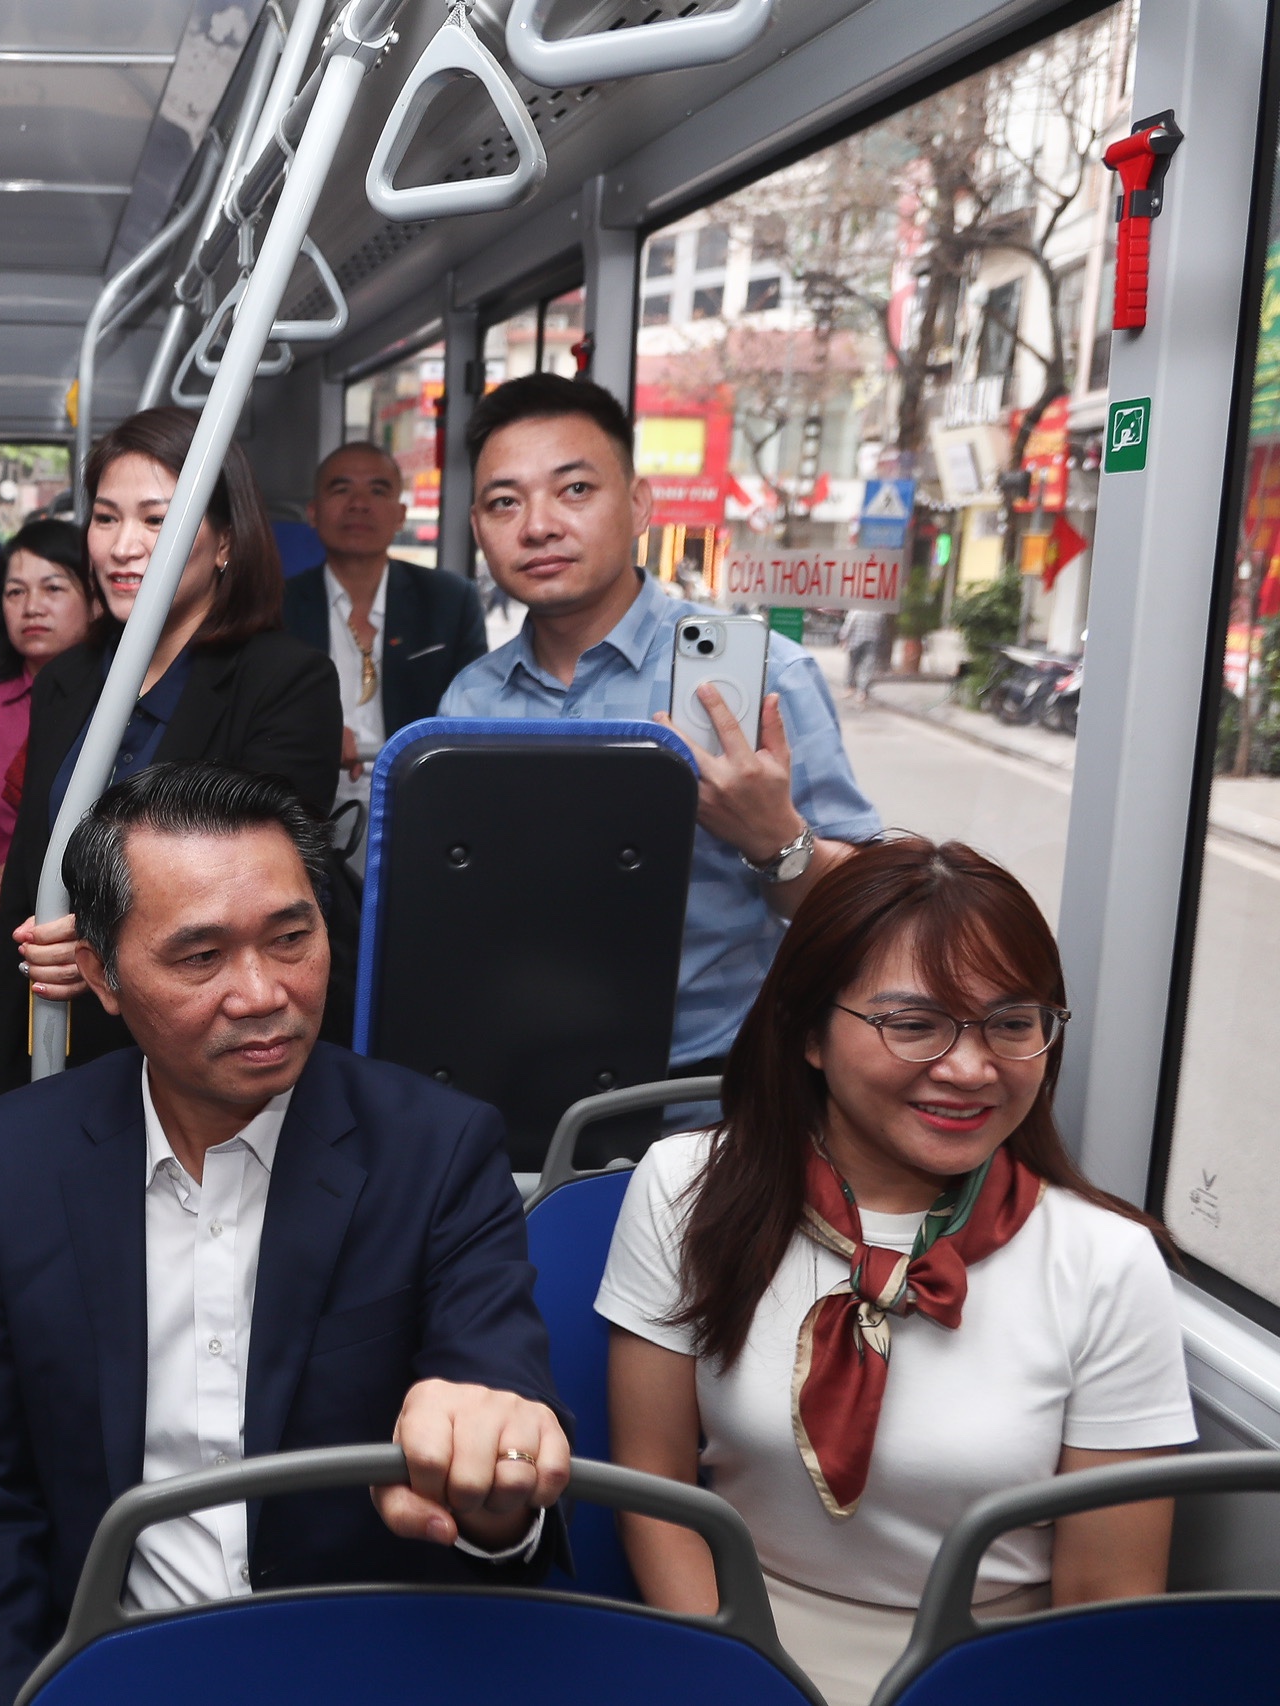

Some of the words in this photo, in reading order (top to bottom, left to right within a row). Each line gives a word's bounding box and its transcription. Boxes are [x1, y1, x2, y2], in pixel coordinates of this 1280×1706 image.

[727, 553, 767, 594] CỬA
[770, 553, 837, 597] THOÁT
[839, 553, 899, 601] HIỂM
